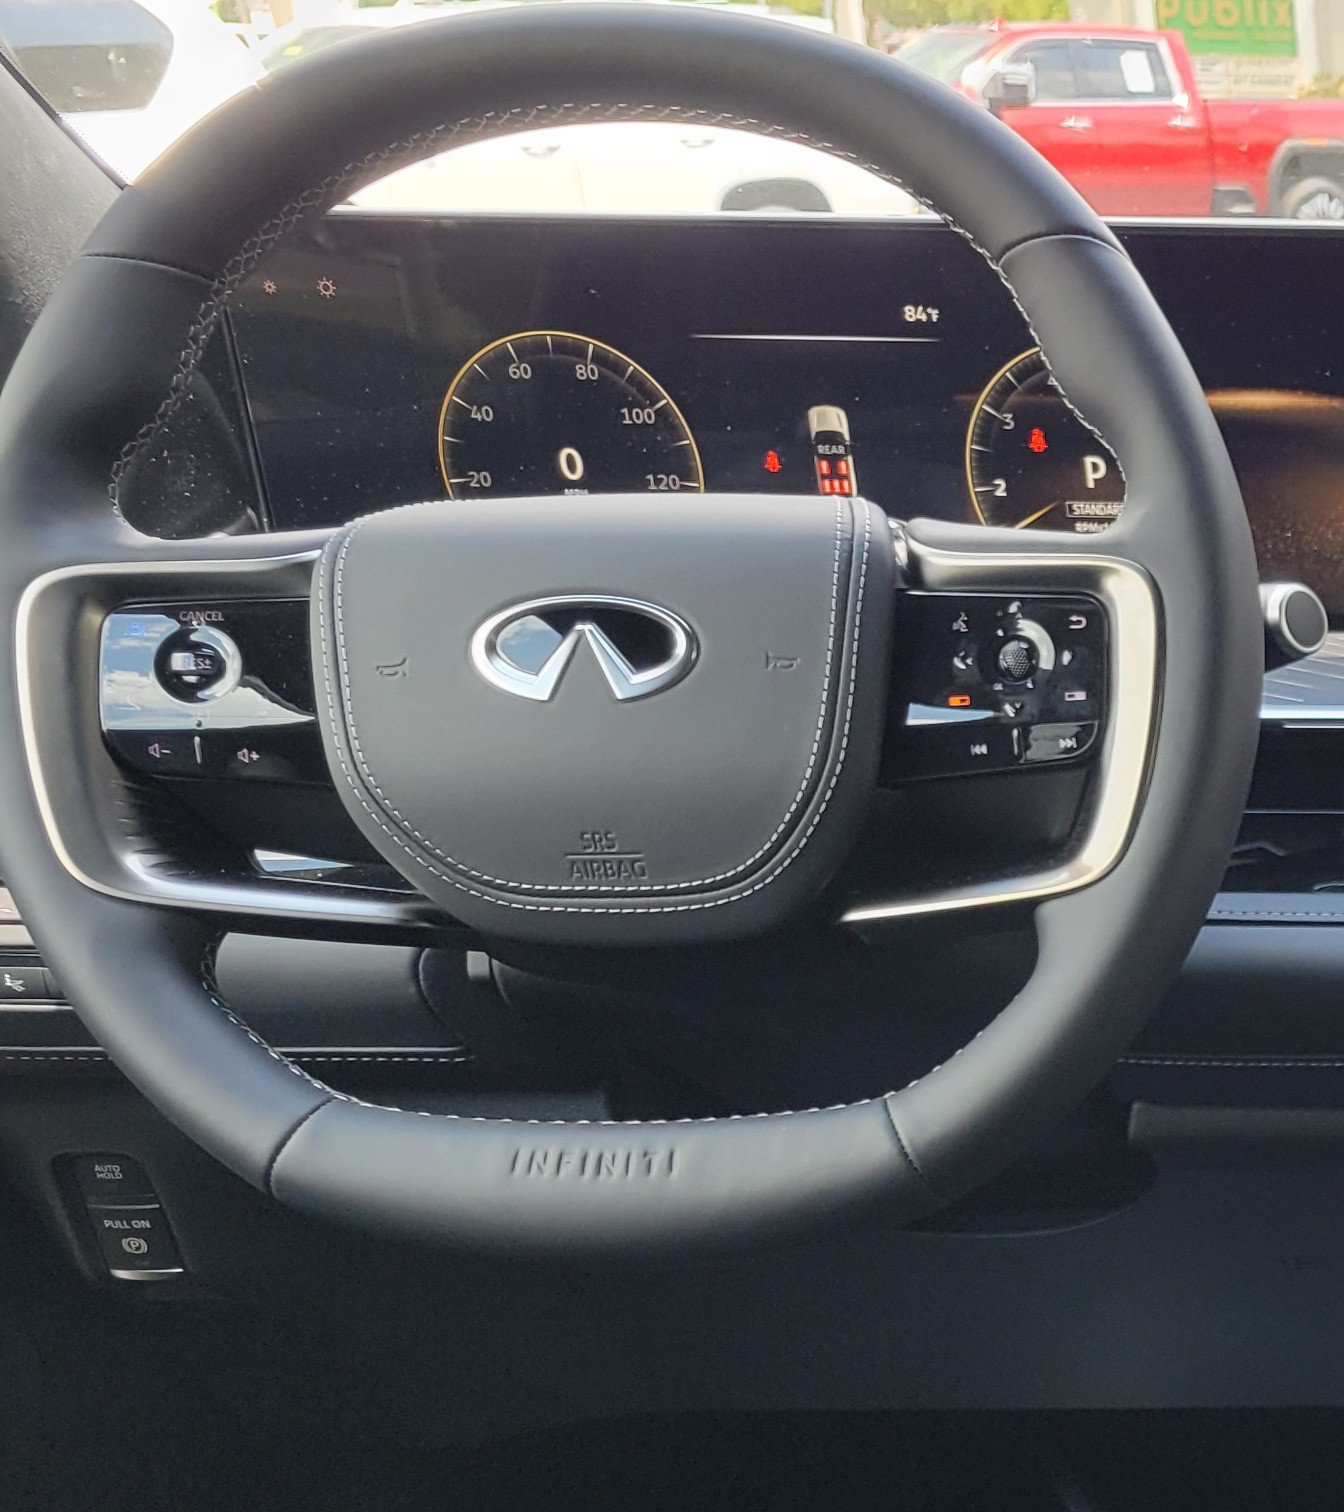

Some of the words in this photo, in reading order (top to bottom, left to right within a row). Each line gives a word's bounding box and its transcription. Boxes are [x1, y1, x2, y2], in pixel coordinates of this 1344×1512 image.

[508, 363, 532, 380] 60
[575, 364, 599, 381] 80
[470, 406, 494, 423] 40
[621, 408, 656, 425] 100
[1002, 413, 1015, 430] 3
[817, 445, 846, 456] REAR
[558, 447, 585, 481] 0
[1082, 455, 1107, 489] P
[468, 471, 492, 488] 20
[646, 475, 681, 491] 120
[993, 479, 1008, 497] 2
[1072, 503, 1124, 516] STANDAR
[179, 611, 225, 622] CANCEL
[581, 832, 618, 853] SRS
[571, 860, 648, 881] AIRBAG
[94, 1164, 120, 1173] AUTO
[510, 1148, 681, 1179] INFINITI
[96, 1172, 122, 1180] HOLD
[103, 1220, 131, 1229] PULL
[132, 1220, 151, 1229] ON
